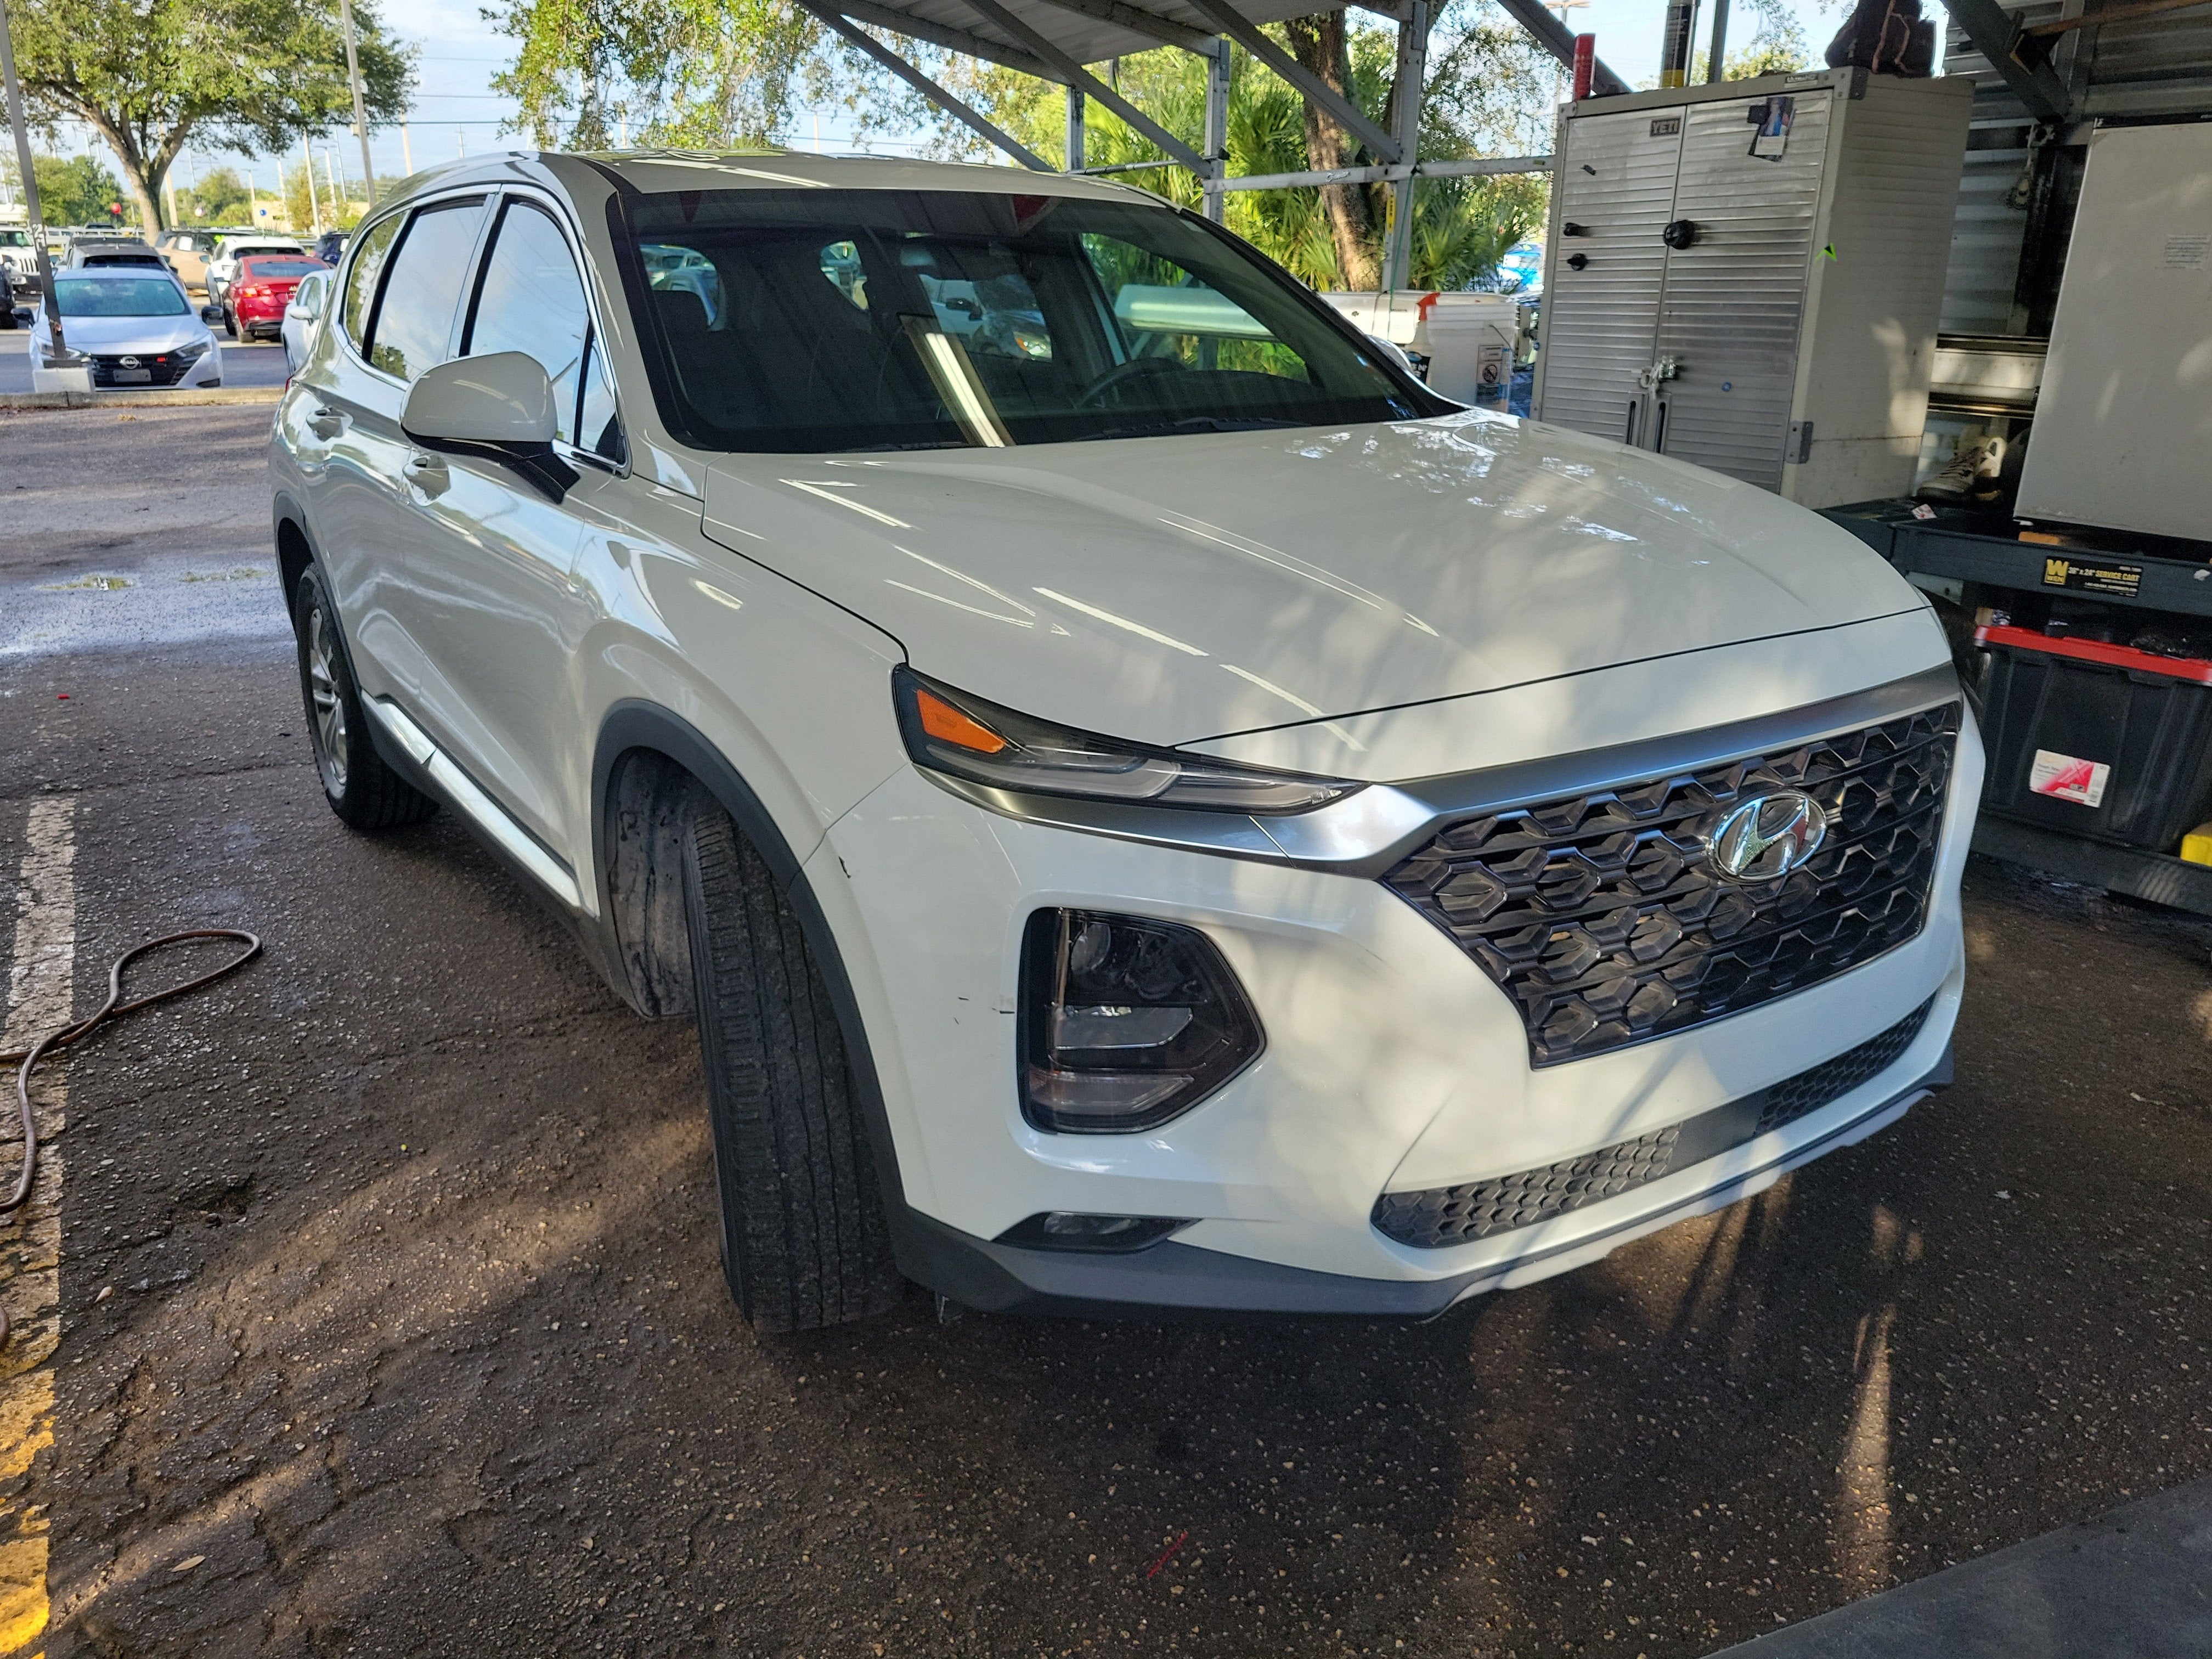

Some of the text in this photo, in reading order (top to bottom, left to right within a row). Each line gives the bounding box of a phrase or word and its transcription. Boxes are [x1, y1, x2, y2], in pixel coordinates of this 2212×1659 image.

[1652, 120, 1679, 133] YETI
[2095, 571, 2122, 580] SERVICE
[2122, 573, 2140, 582] CART
